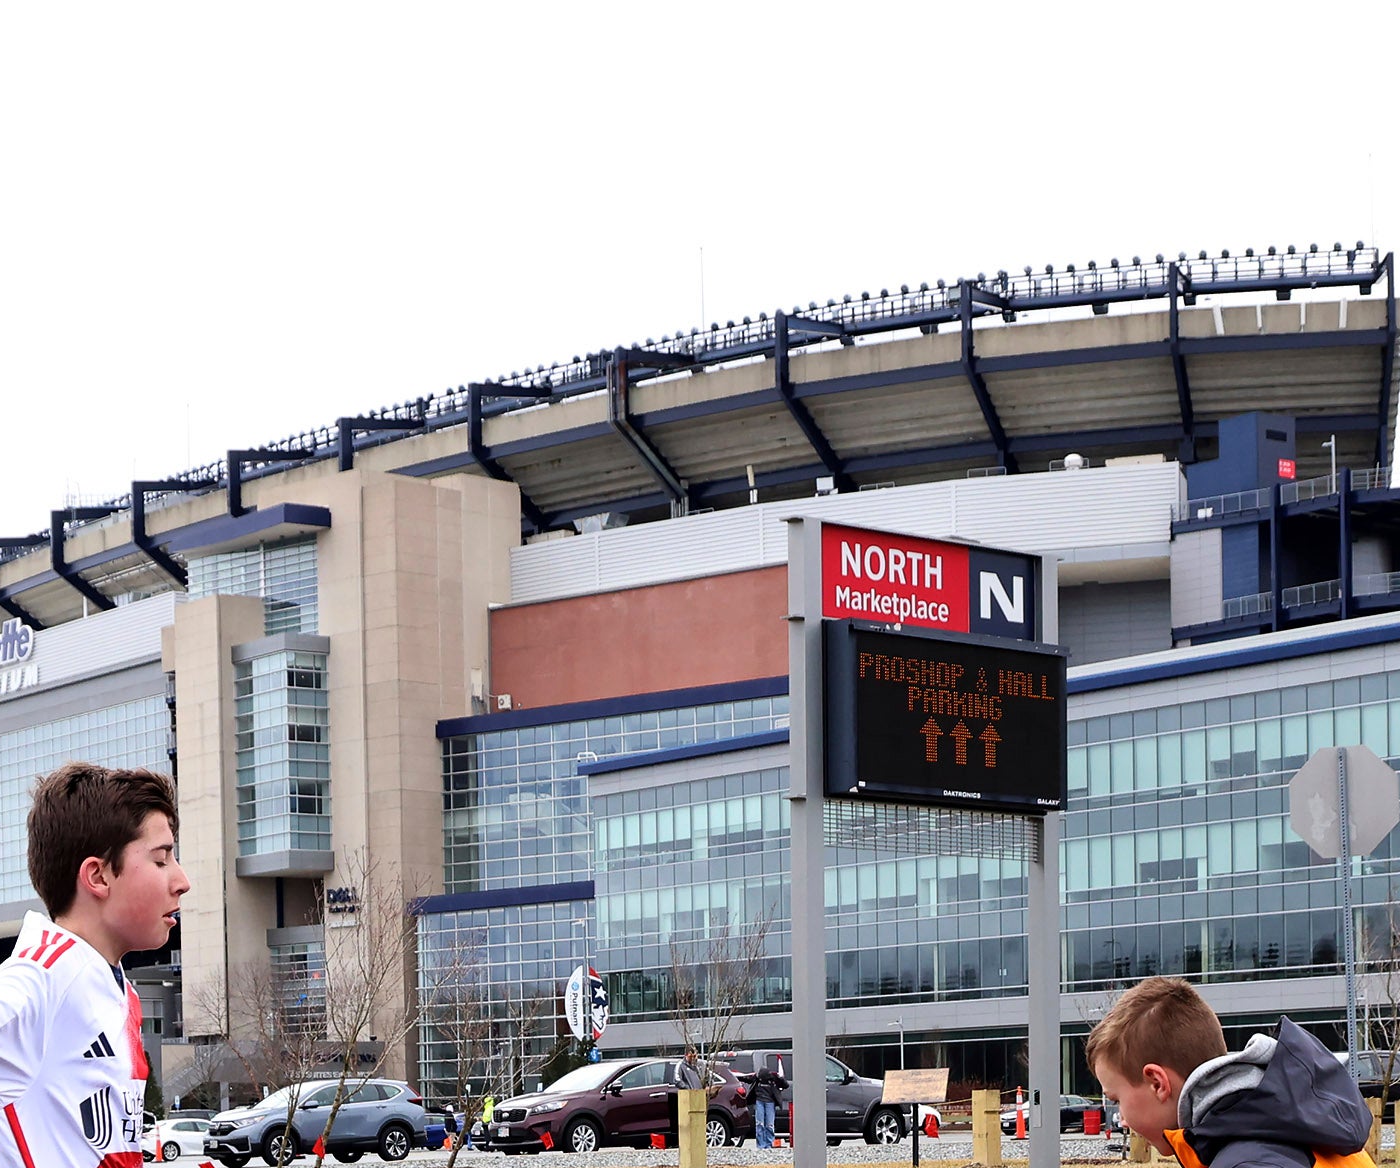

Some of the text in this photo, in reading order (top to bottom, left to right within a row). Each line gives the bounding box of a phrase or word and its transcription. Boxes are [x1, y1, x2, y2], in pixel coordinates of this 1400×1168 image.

[840, 540, 943, 590] NORTH
[835, 585, 949, 623] Marketplace
[979, 570, 1025, 624] N
[859, 652, 965, 688] PROSHOP
[998, 669, 1055, 701] HALL
[907, 686, 1003, 721] PARKING
[943, 789, 981, 799] DAKTRONICS
[1037, 798, 1060, 806] GALAXY
